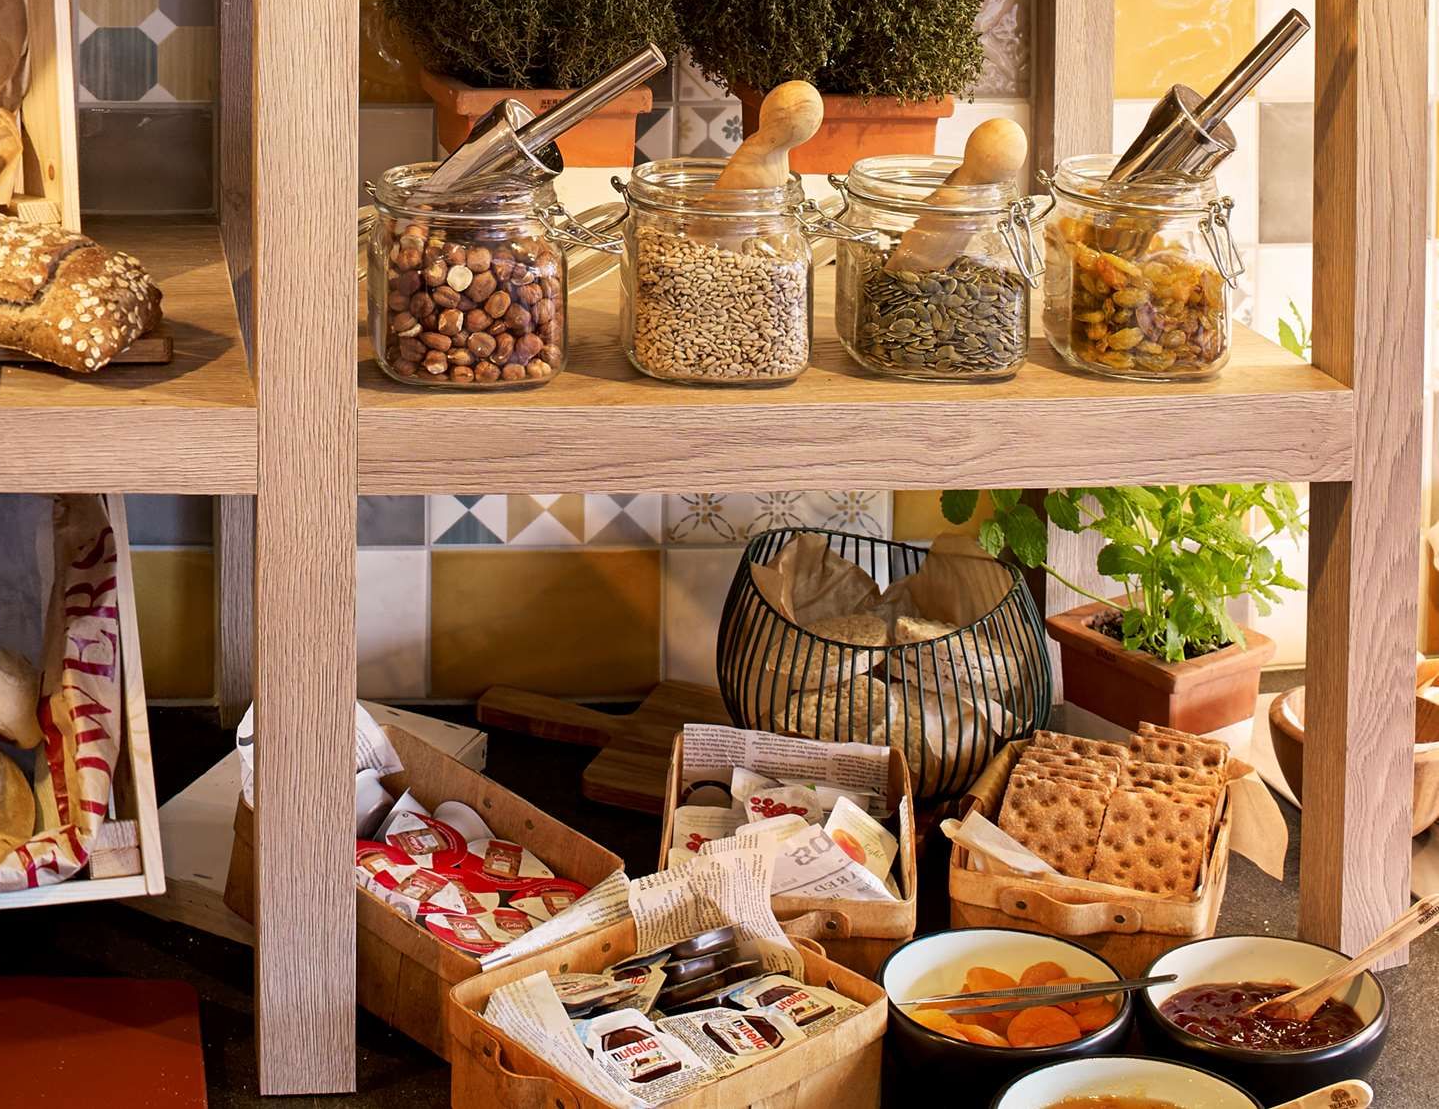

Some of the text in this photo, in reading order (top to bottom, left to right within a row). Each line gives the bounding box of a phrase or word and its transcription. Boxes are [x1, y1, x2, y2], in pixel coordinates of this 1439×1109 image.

[775, 991, 811, 1012] utella
[733, 1019, 769, 1051] nutella
[610, 1039, 659, 1063] nutella
